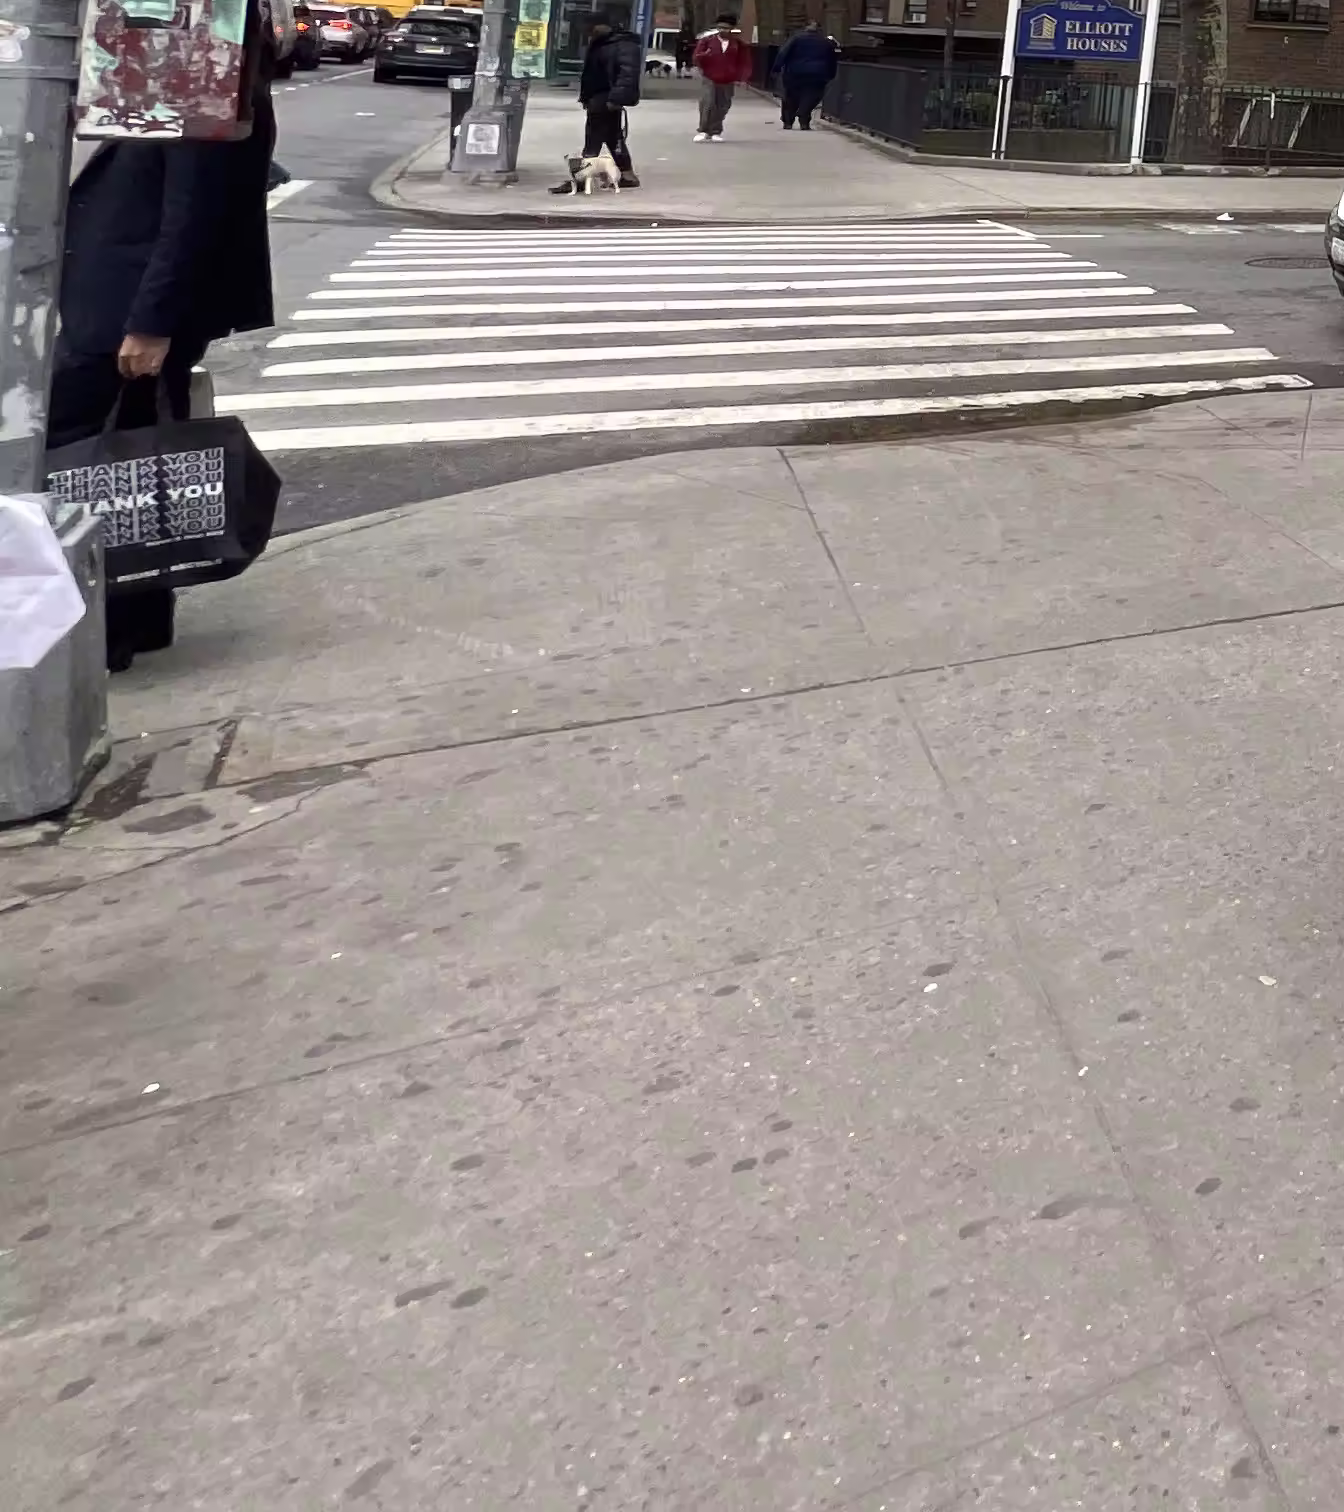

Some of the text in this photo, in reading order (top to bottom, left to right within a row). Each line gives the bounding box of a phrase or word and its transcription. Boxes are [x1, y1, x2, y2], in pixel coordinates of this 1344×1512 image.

[1065, 20, 1133, 36] ELLIOTT
[1067, 37, 1128, 53] HOUSES
[47, 446, 224, 485] THANK YOU
[166, 481, 224, 501] YOU
